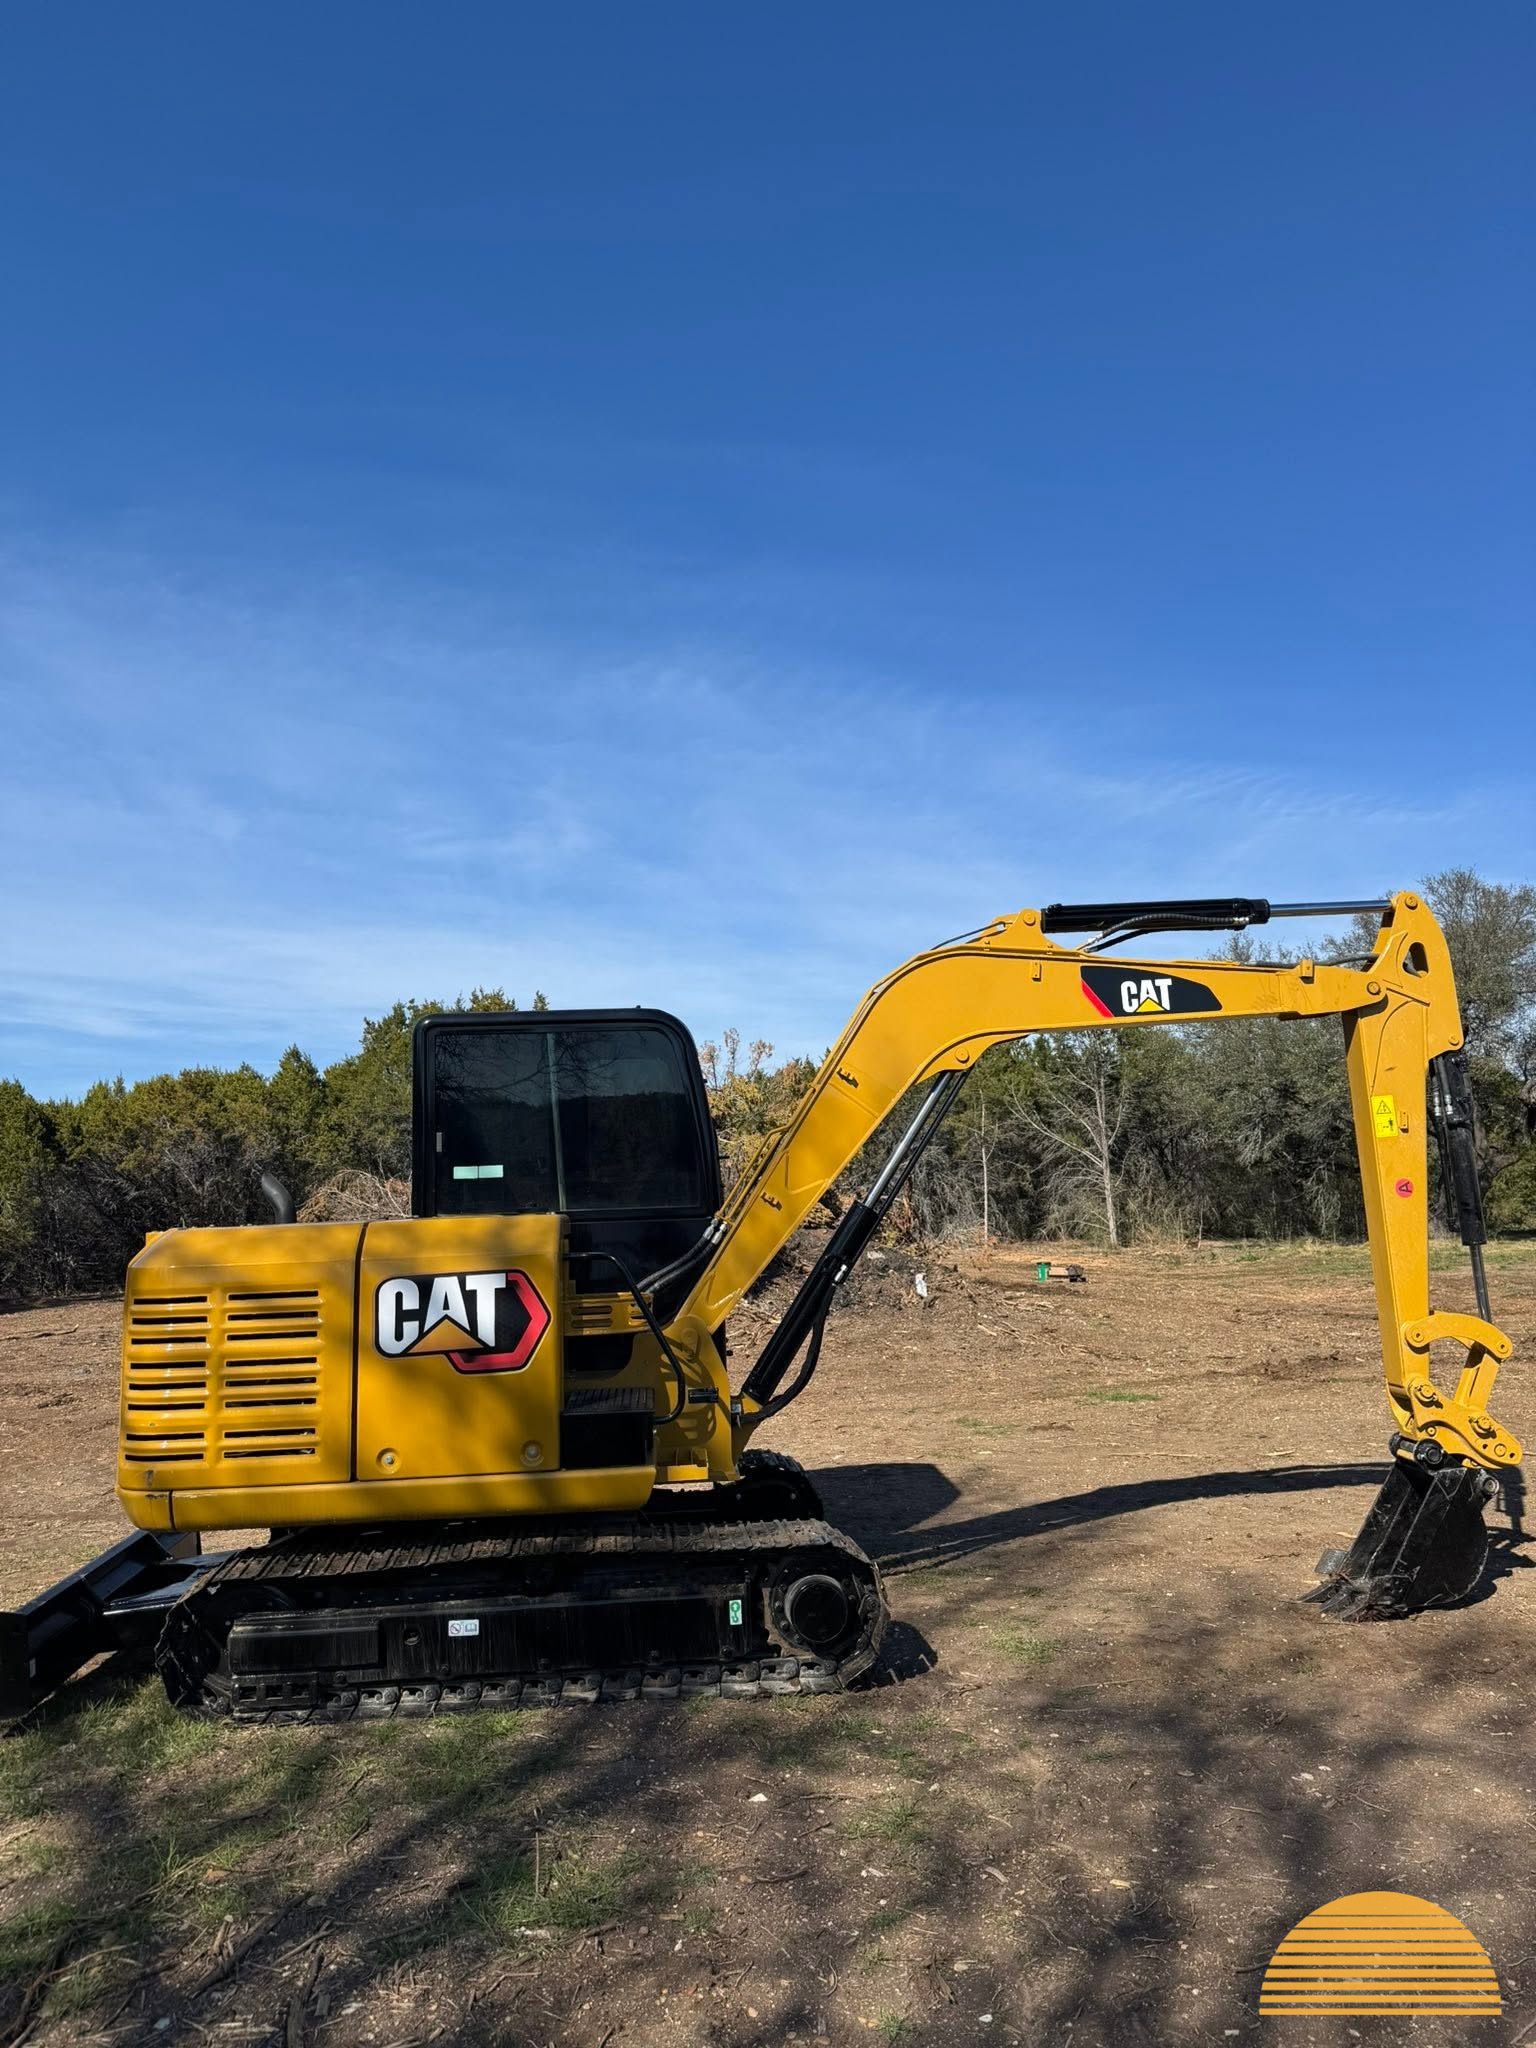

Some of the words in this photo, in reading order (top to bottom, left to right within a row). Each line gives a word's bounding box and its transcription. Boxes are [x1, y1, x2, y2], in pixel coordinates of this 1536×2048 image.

[1120, 978, 1172, 1013] CAT
[1398, 1180, 1412, 1194] A
[378, 1273, 507, 1354] CAT
